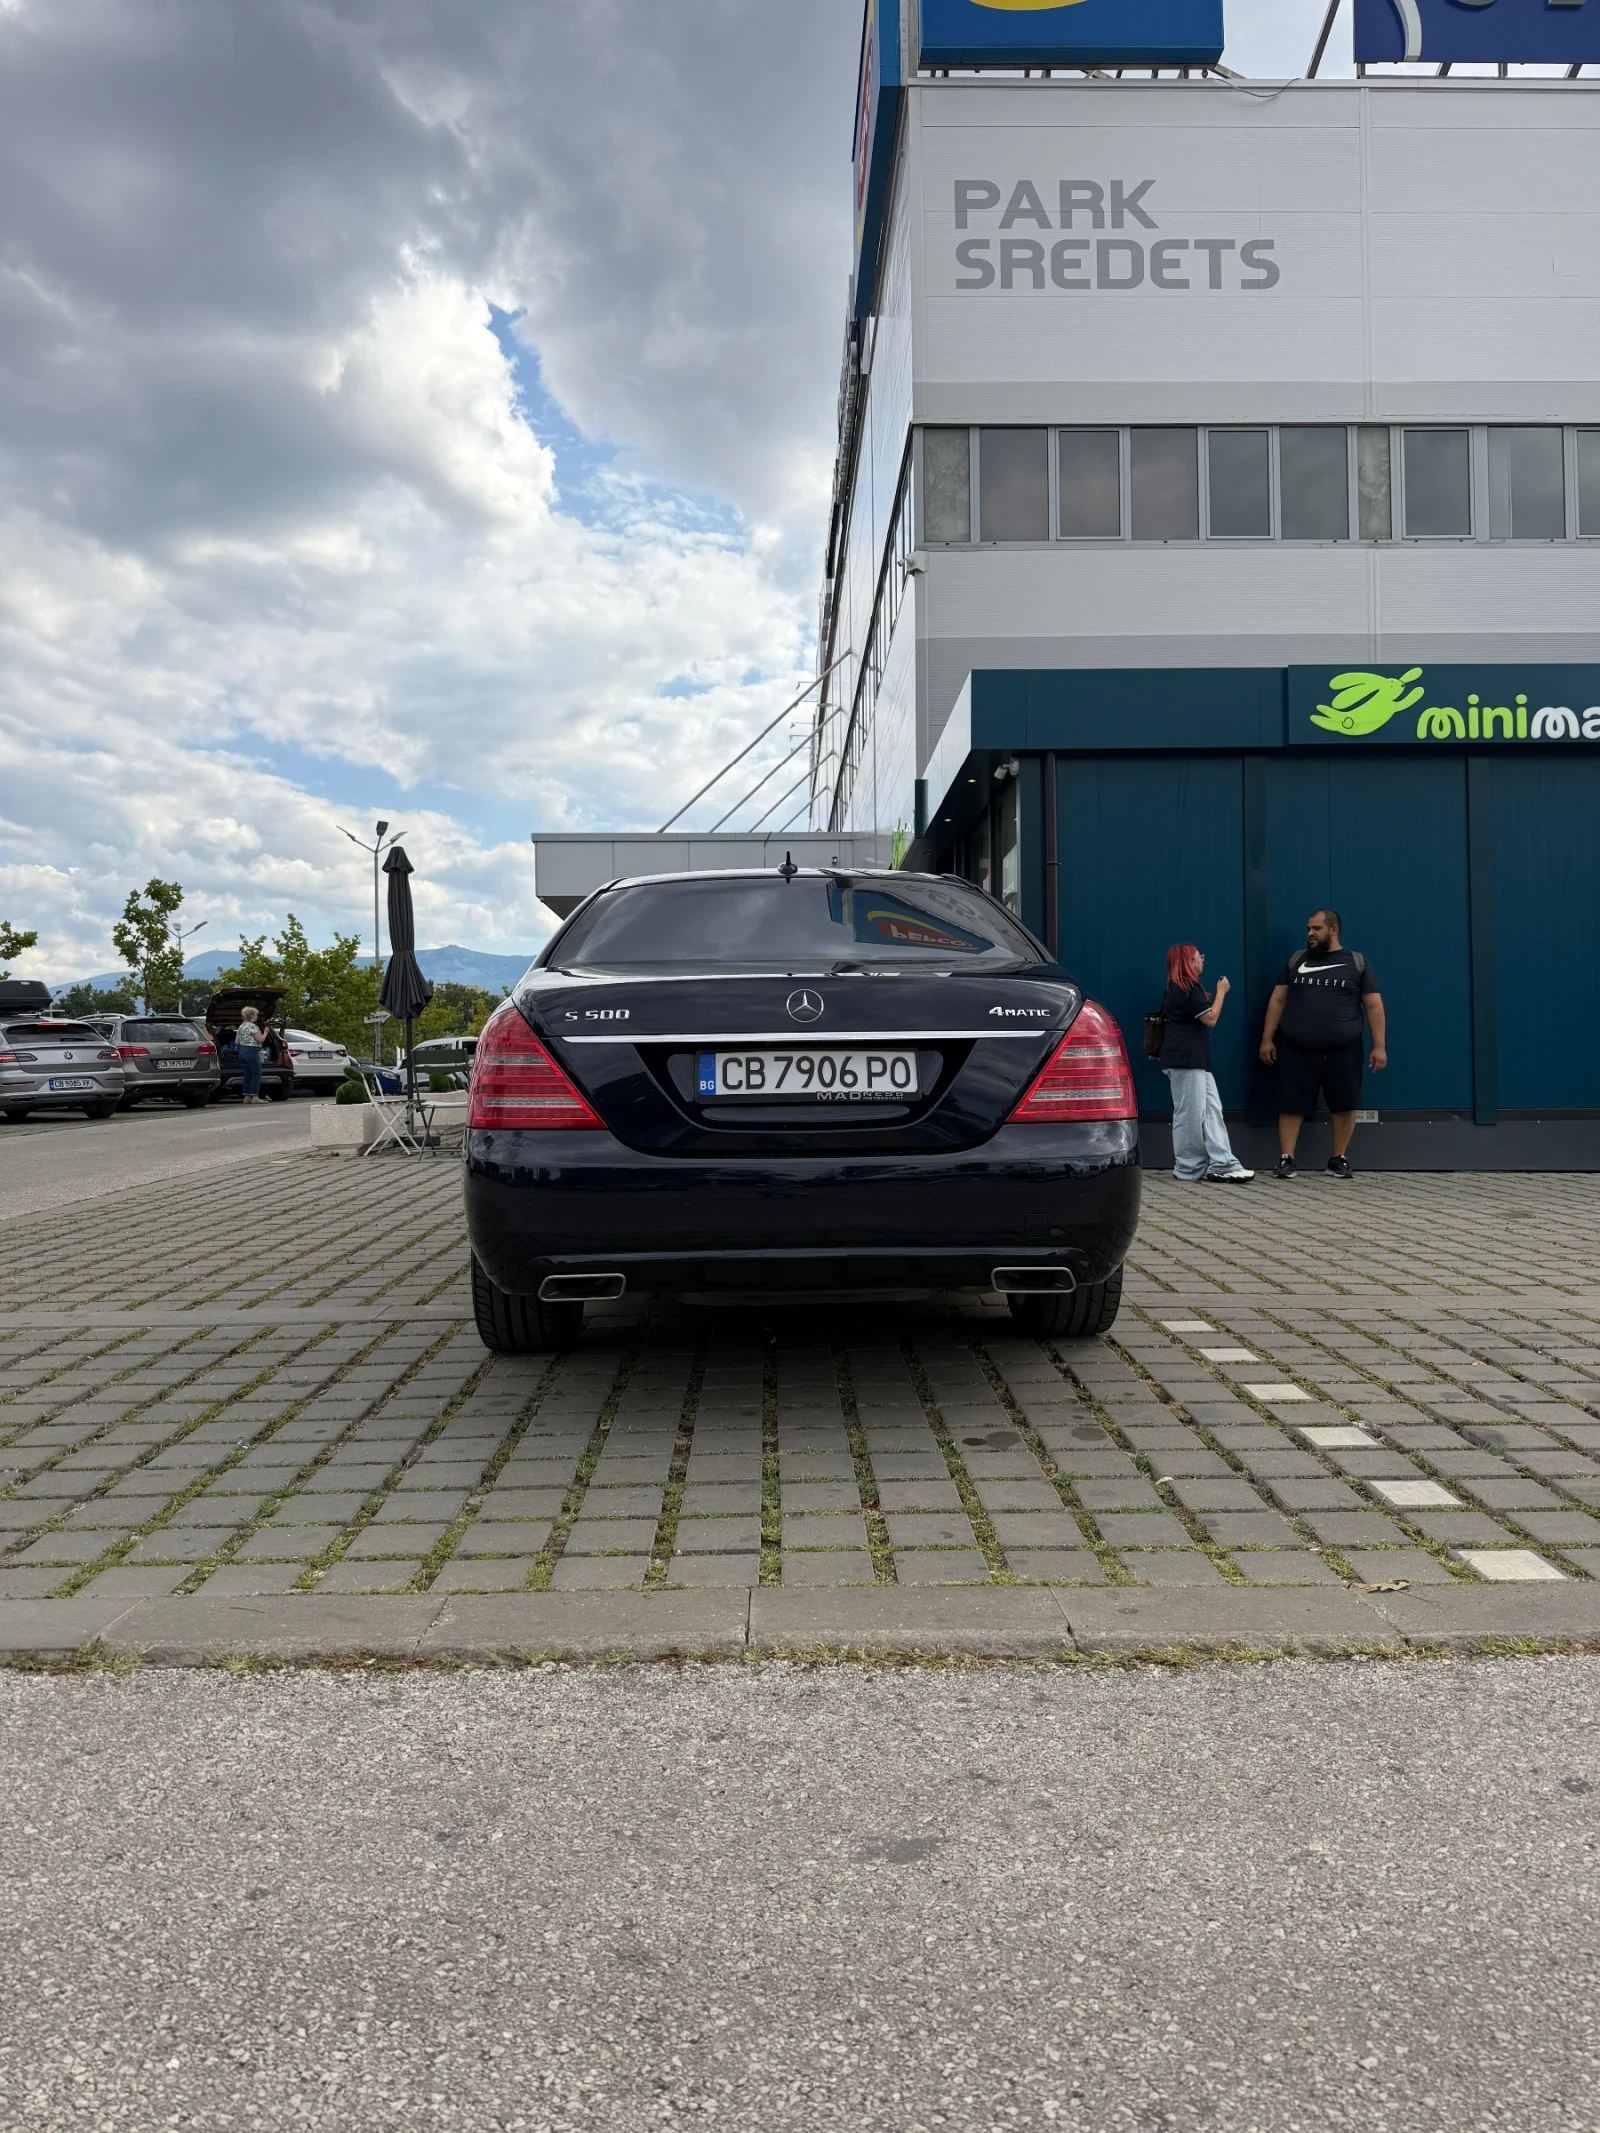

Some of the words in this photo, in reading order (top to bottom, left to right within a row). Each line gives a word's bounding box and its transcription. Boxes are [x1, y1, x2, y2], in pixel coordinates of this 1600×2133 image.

[953, 179, 1160, 230] PARK
[955, 239, 1281, 290] SREDETS
[1294, 977, 1346, 988] ATHLETE
[565, 1010, 578, 1022] S
[585, 1009, 630, 1020] 500
[988, 1006, 1051, 1017] 4MATIC
[722, 1056, 766, 1090] CB
[773, 1055, 859, 1089] 7906
[55, 1080, 64, 1088] CB
[700, 1080, 715, 1091] BG
[816, 1090, 904, 1101] MADNESS
